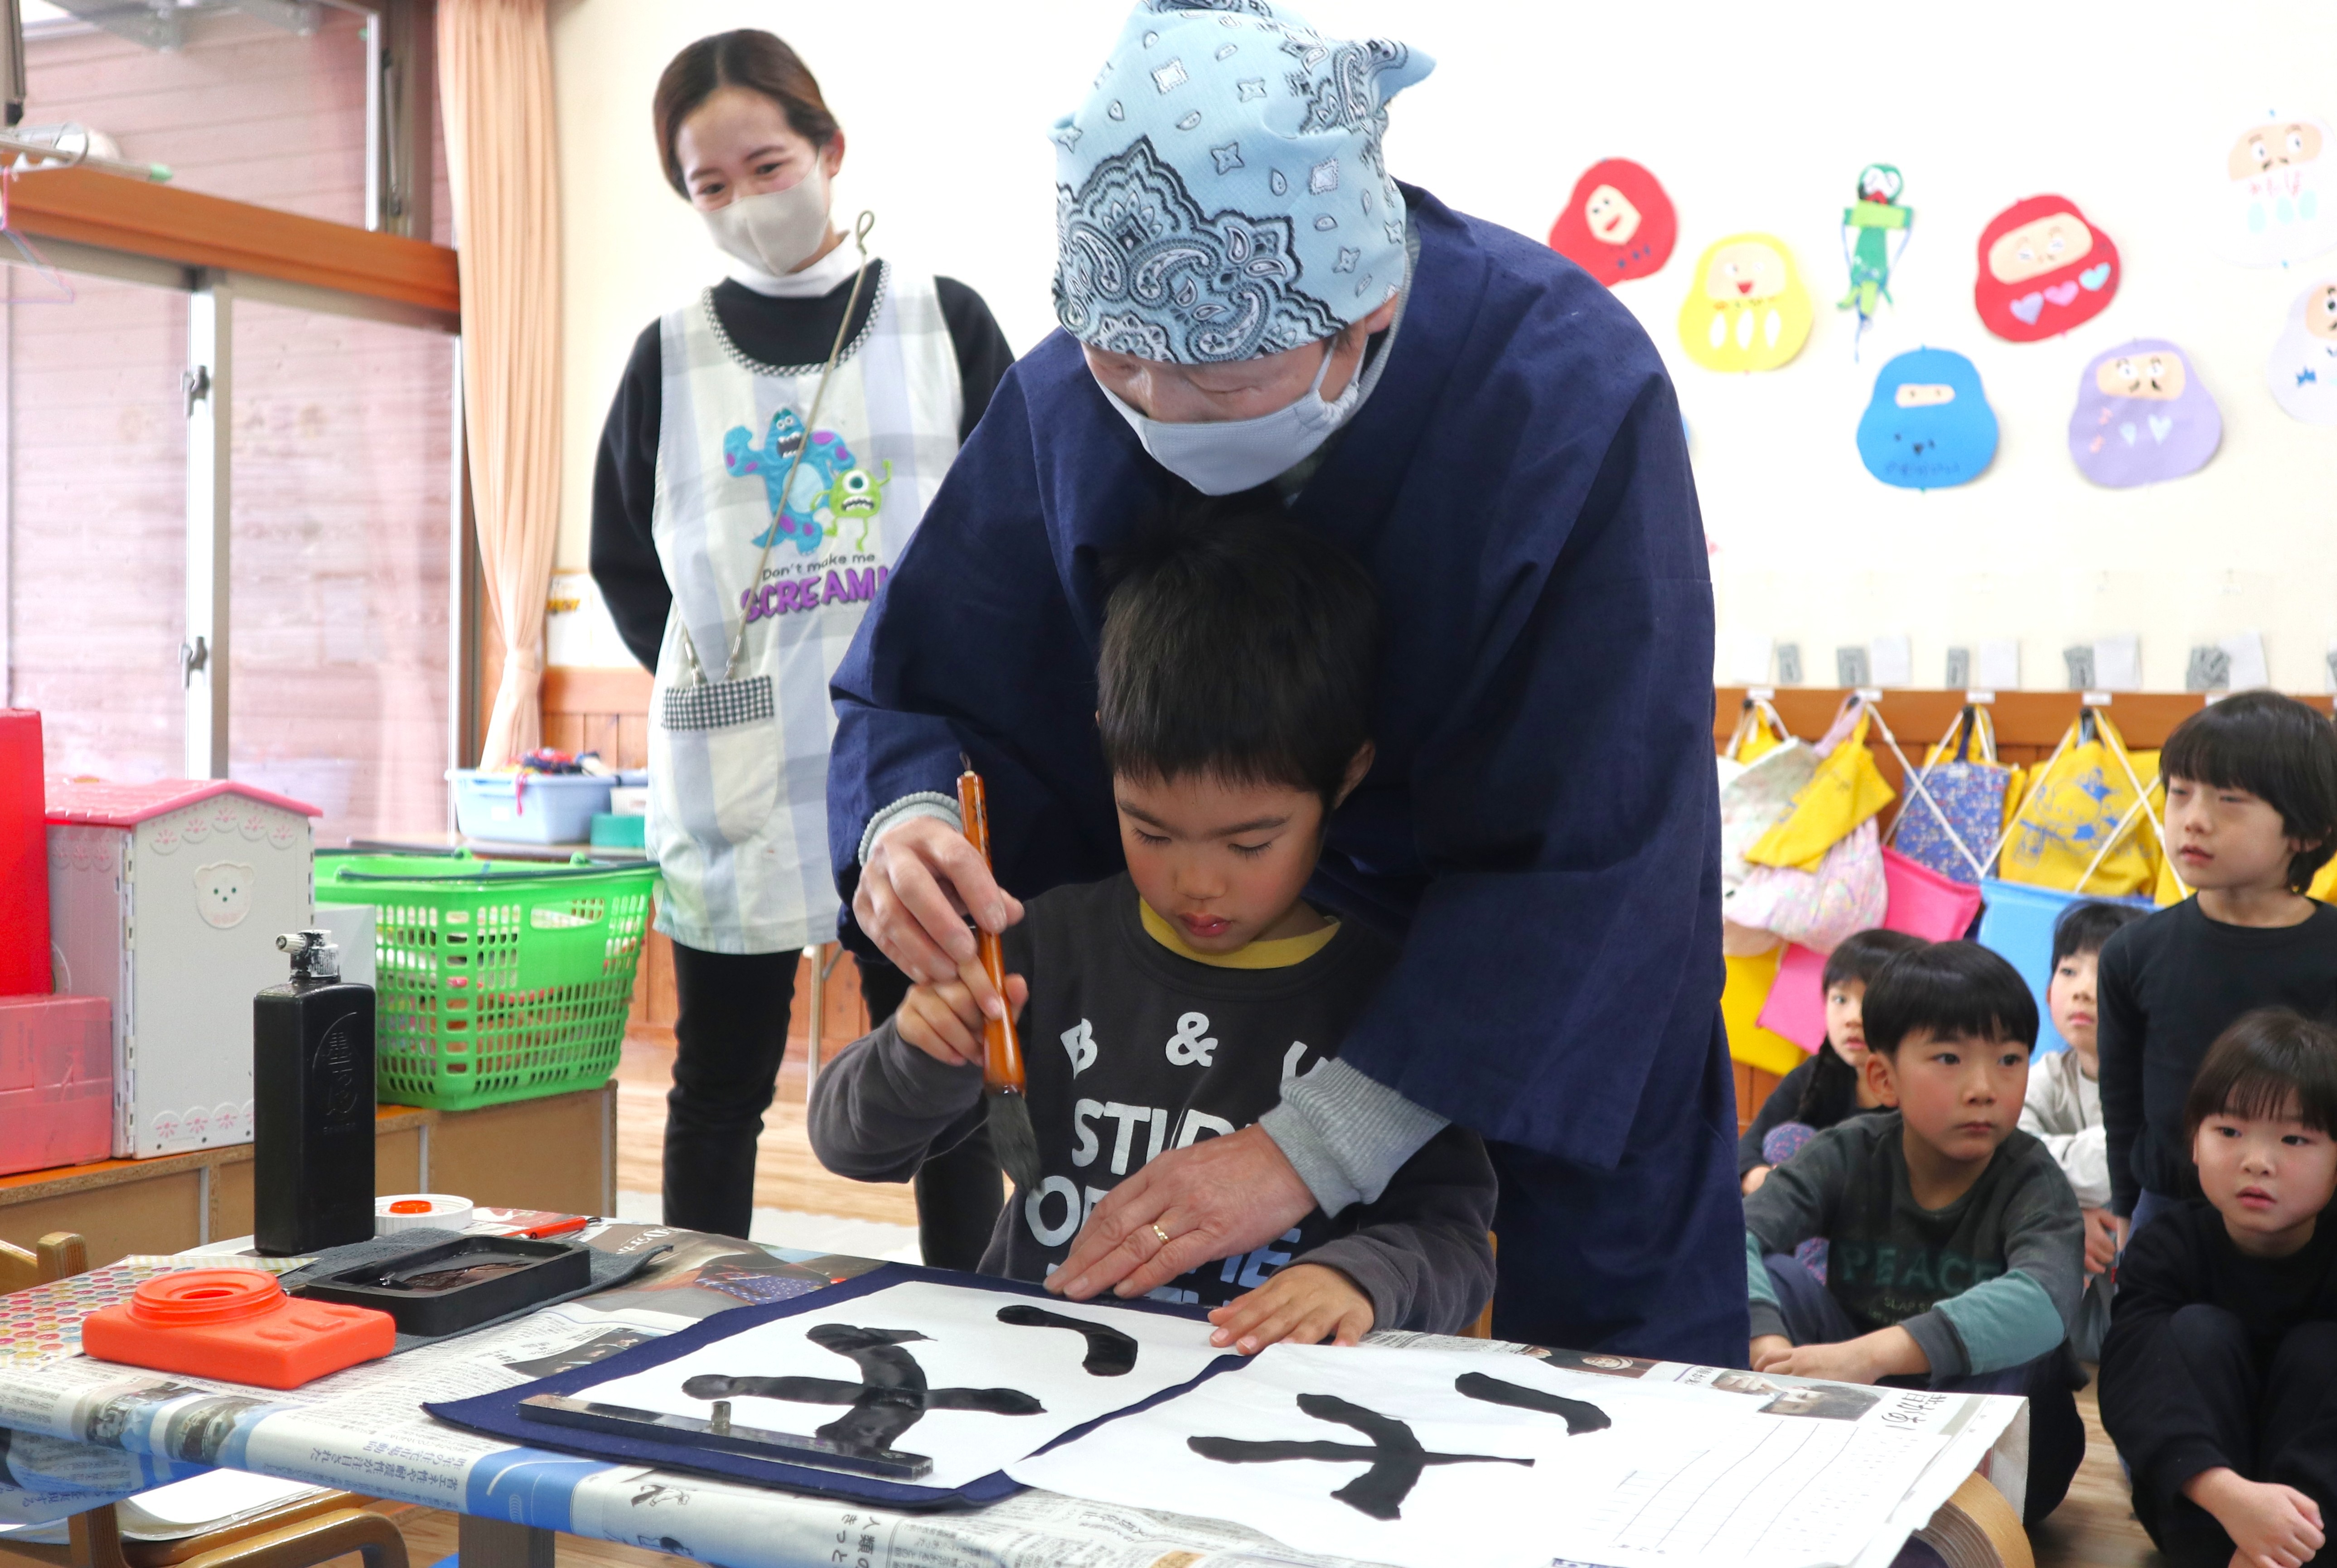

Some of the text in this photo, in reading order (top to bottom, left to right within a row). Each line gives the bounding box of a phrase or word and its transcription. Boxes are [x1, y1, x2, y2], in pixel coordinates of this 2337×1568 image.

[762, 553, 876, 581] Don't make me
[1165, 1012, 1218, 1067] &
[309, 1447, 458, 1491] 省エネ性や耐震性が注目された
[363, 1440, 468, 1471] 昨年の住宅市場動向
